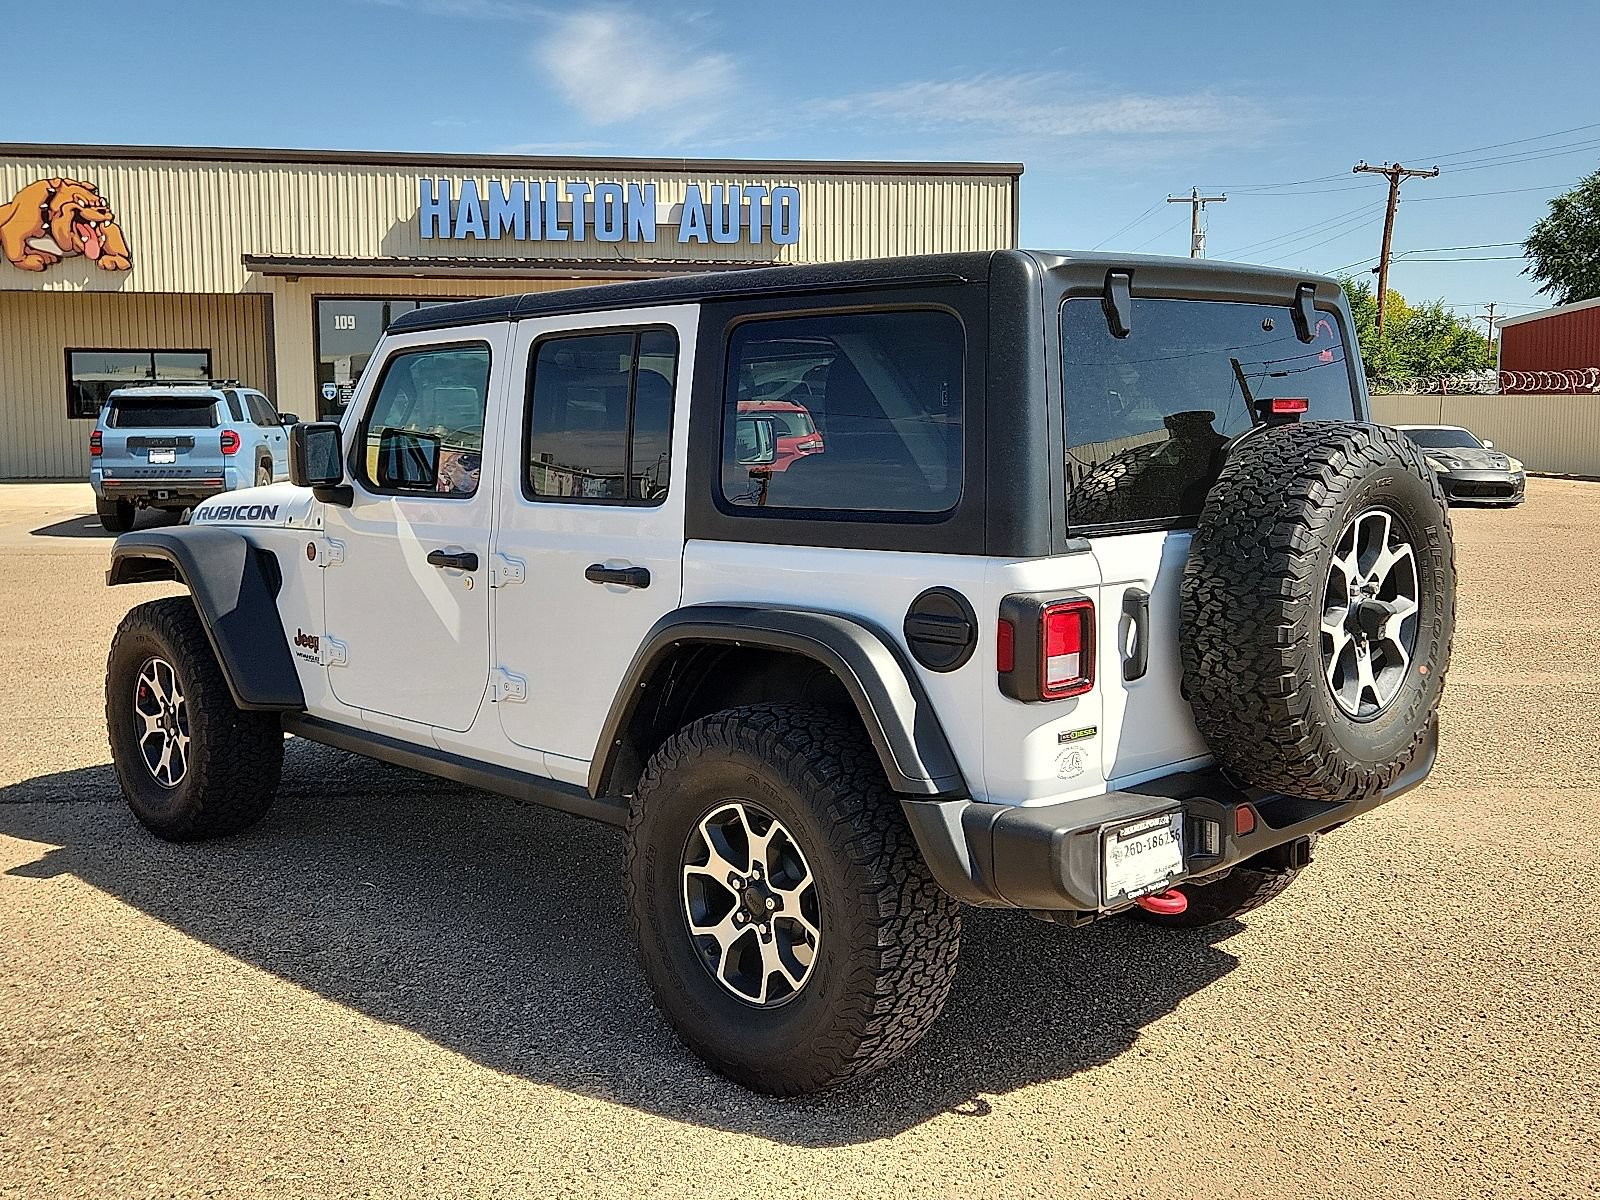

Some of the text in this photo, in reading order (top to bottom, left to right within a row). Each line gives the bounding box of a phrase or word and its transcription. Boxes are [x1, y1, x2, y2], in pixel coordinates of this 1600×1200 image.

[419, 178, 801, 245] HAMILTON AUTO
[334, 315, 356, 330] 109
[196, 505, 279, 520] RUBICON
[293, 627, 320, 654] Jeep
